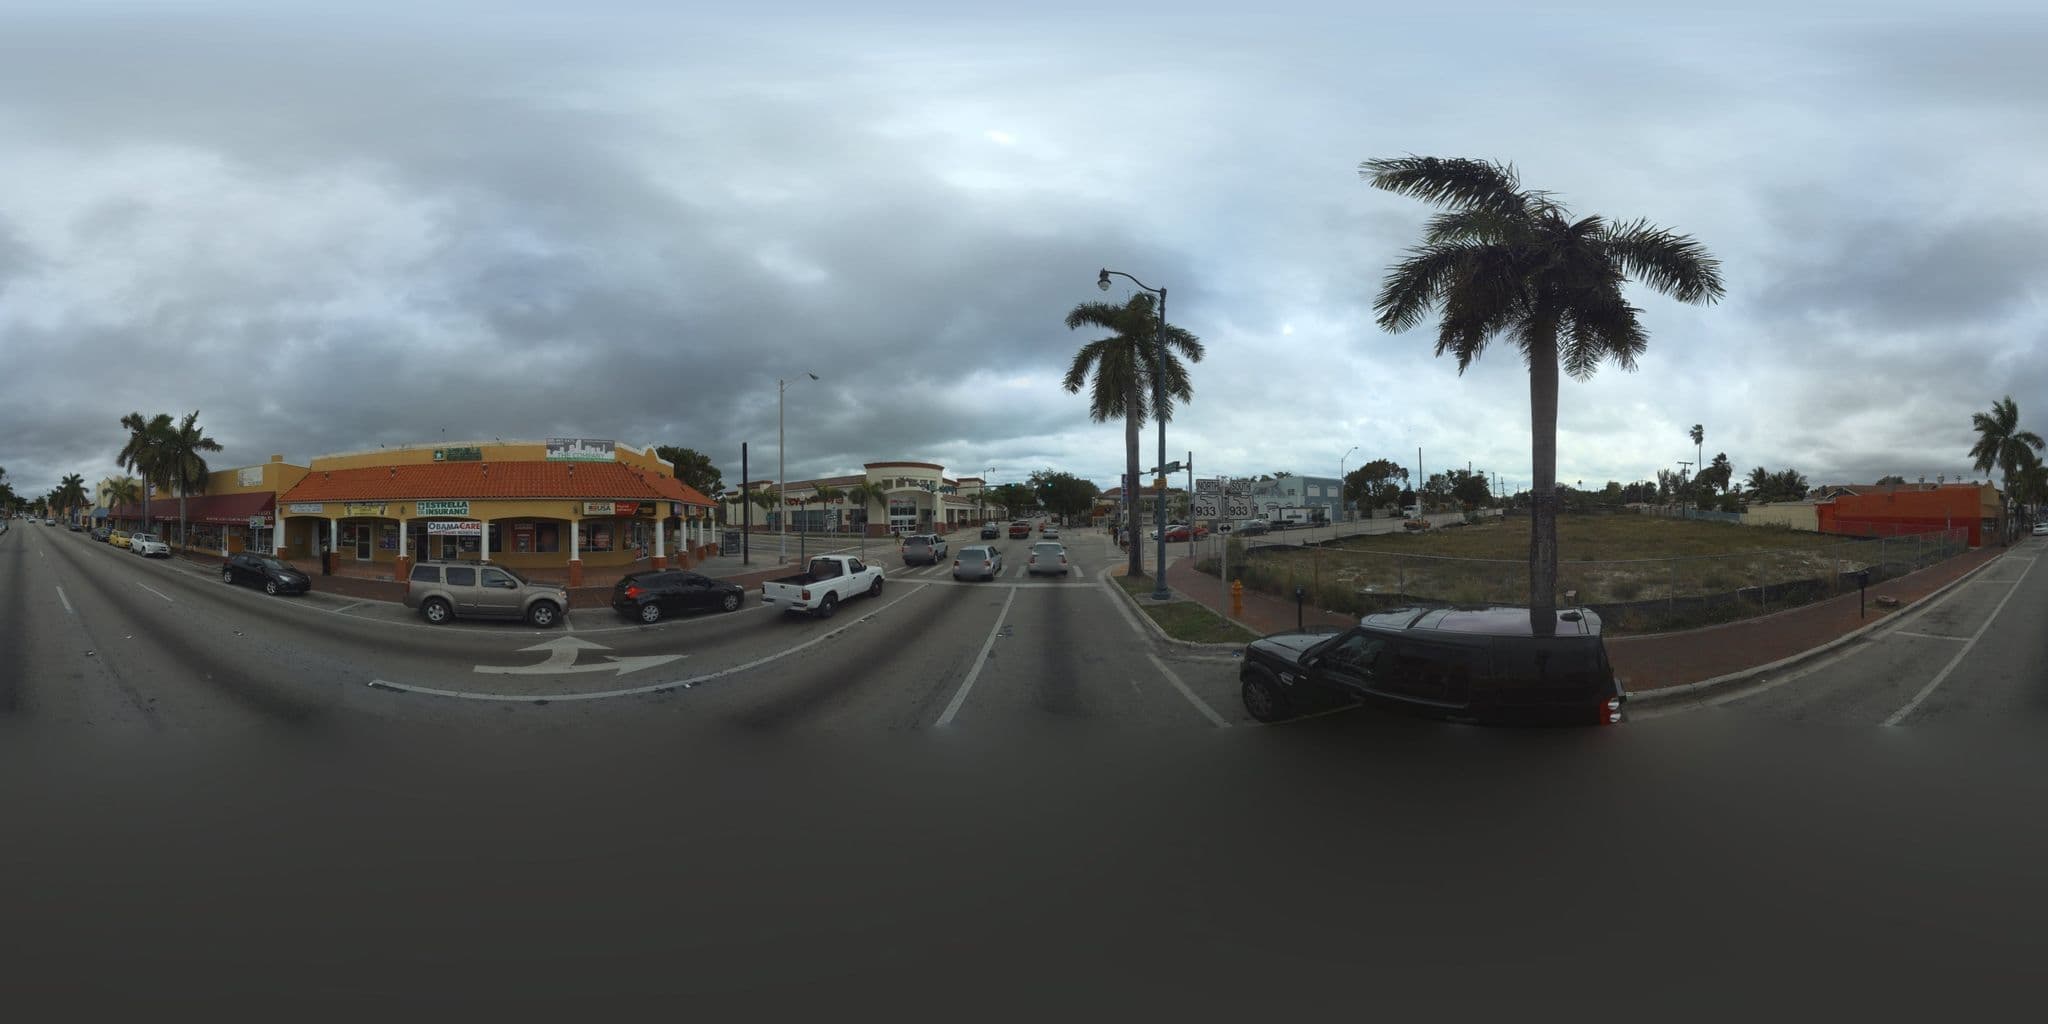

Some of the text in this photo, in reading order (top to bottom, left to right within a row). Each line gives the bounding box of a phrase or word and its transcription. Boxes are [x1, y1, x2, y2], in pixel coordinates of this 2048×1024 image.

[1198, 481, 1218, 491] NORTH
[1231, 481, 1250, 491] SOUTH
[1195, 506, 1216, 516] 933
[1229, 506, 1248, 516] 933
